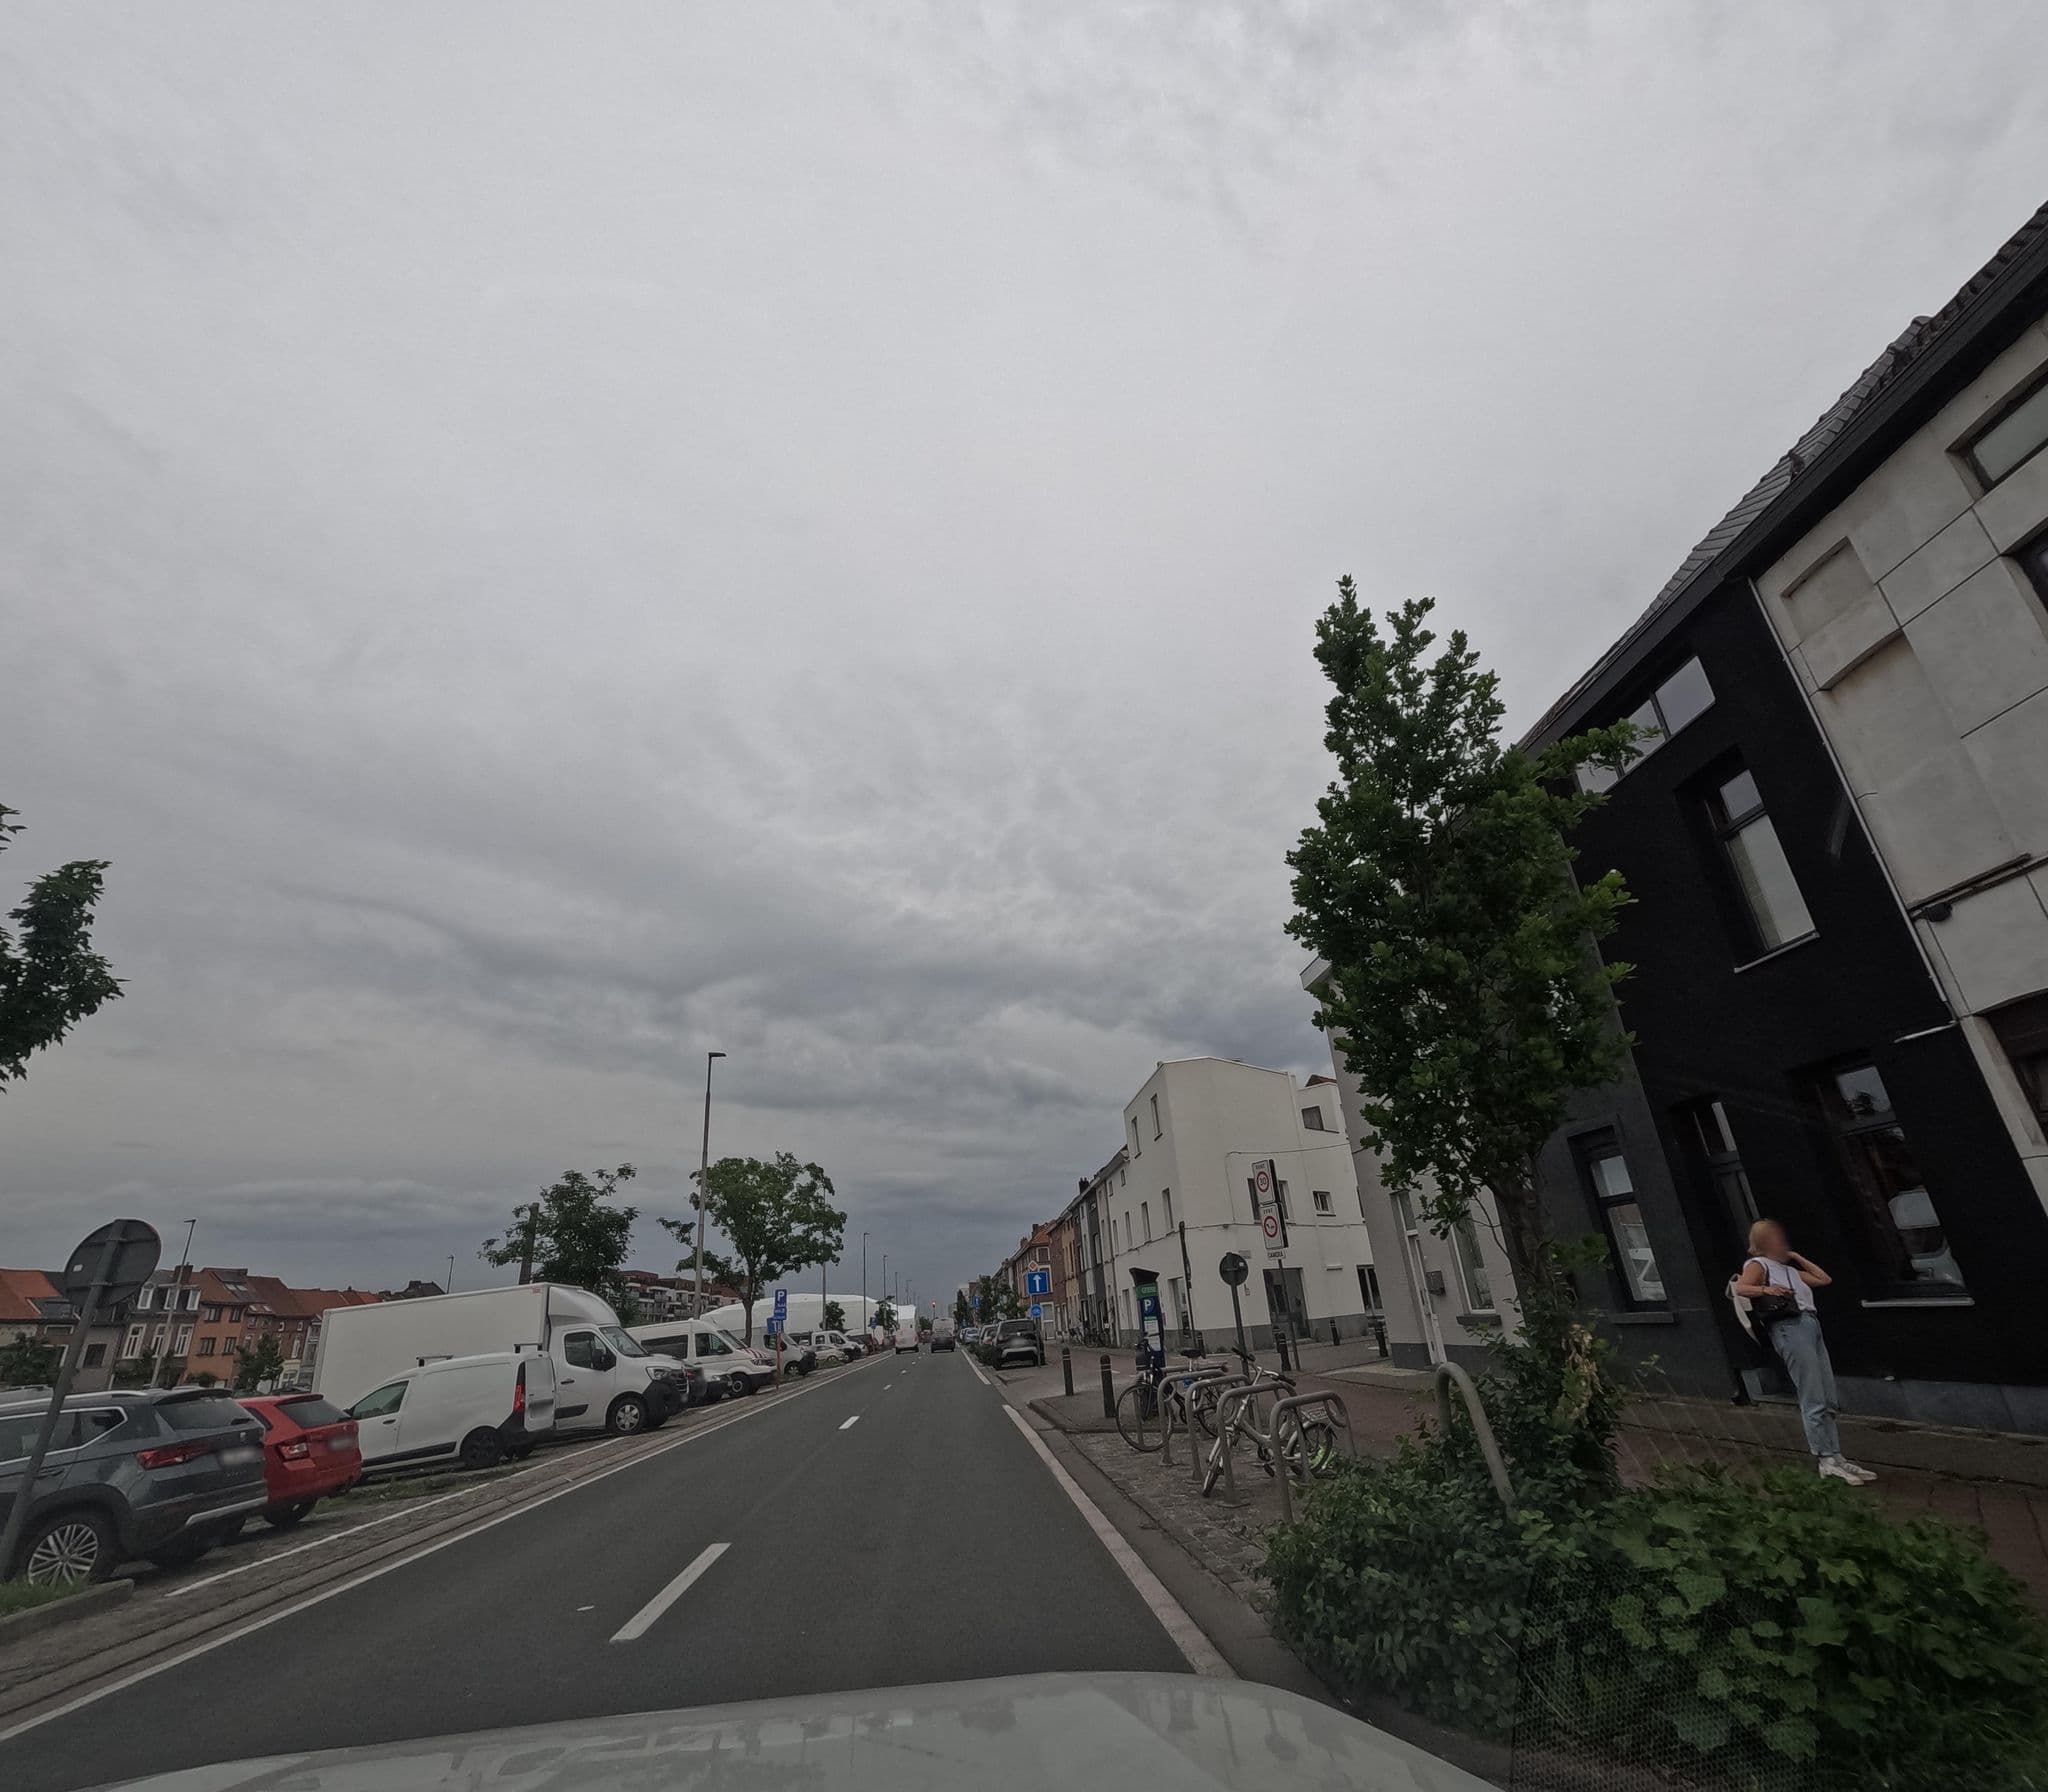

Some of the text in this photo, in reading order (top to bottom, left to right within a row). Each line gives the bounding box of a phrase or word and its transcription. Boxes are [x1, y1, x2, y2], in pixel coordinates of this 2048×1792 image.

[1259, 1176, 1267, 1186] 30
[1266, 1250, 1284, 1259] CAMERA
[777, 1290, 785, 1302] P
[1144, 1299, 1152, 1312] P
